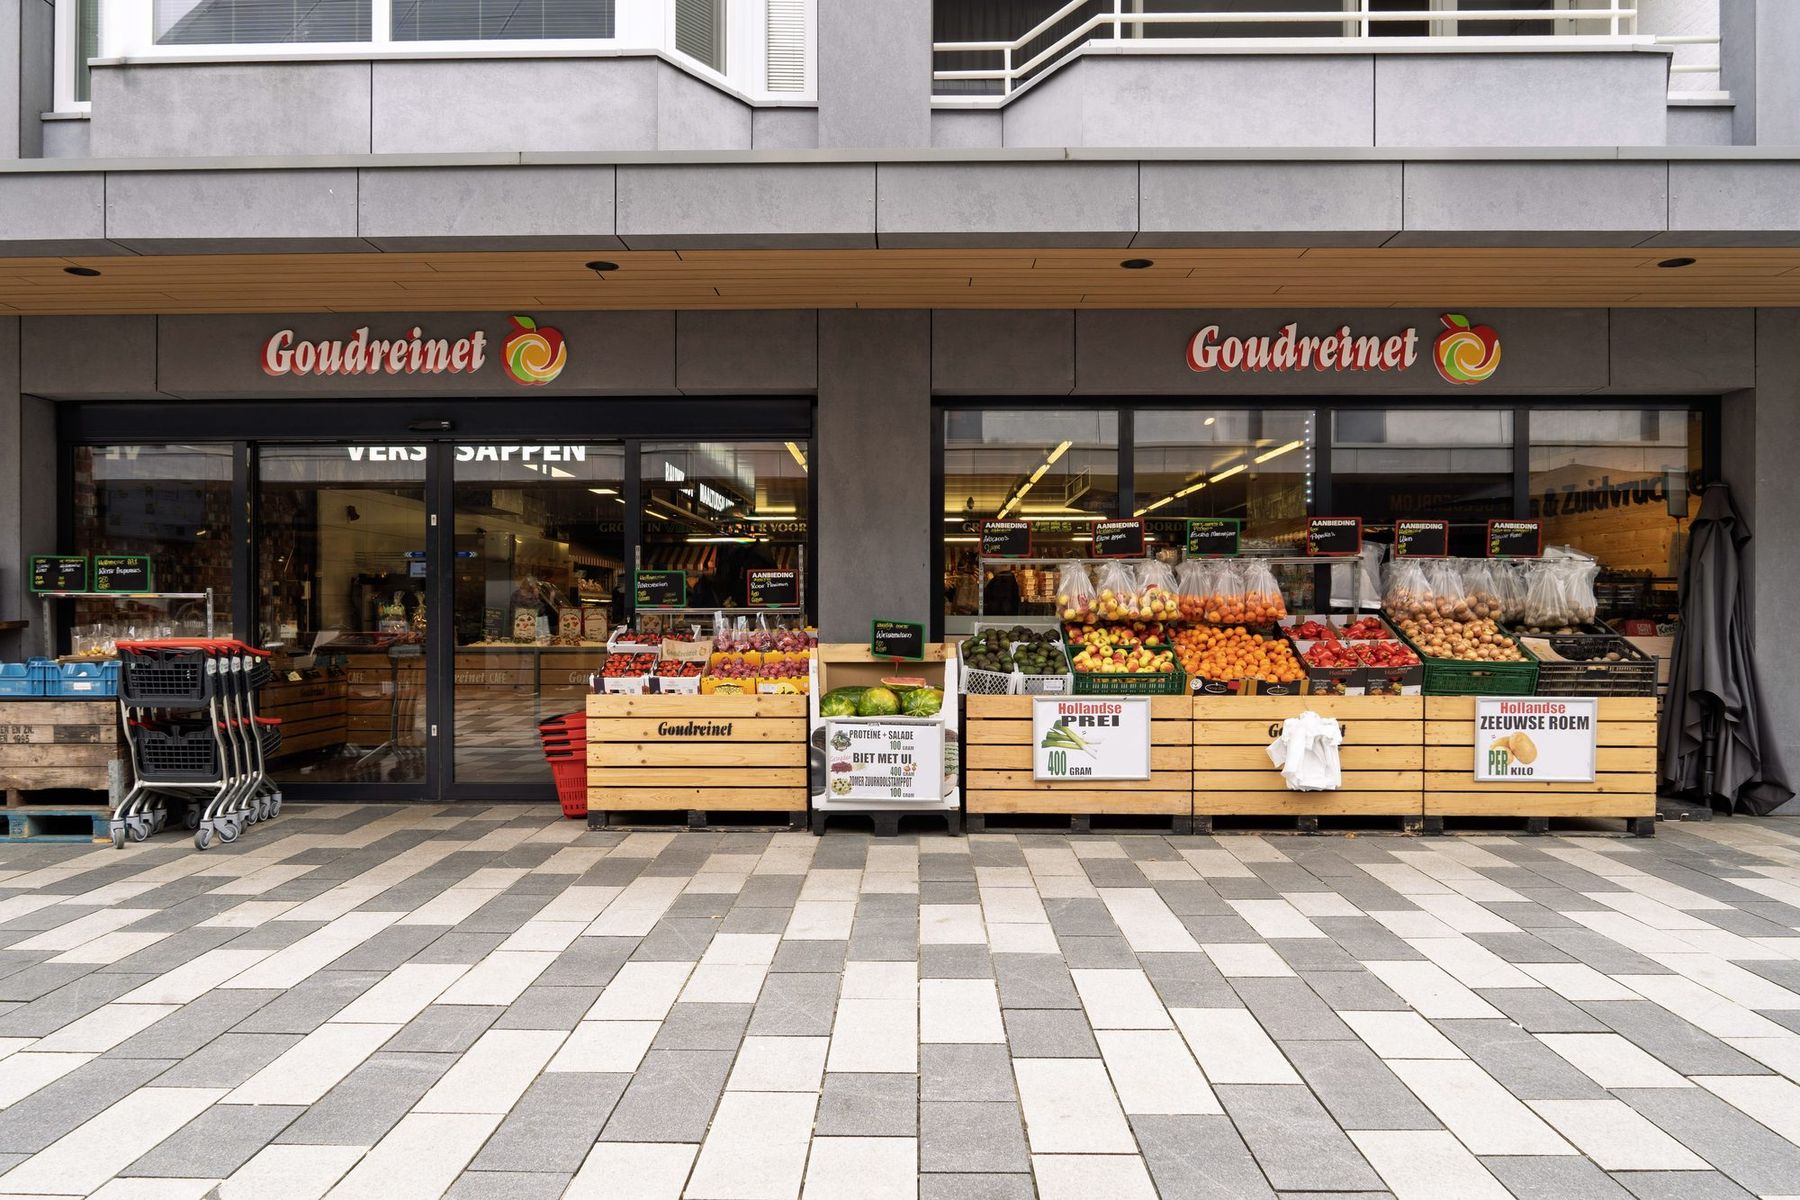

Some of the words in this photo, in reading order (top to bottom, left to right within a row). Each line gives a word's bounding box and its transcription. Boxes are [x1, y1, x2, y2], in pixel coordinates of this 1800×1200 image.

[261, 326, 487, 375] Goudreinet
[1186, 322, 1418, 372] Goudreinet
[985, 521, 1028, 529] AANBIEDING
[1096, 519, 1139, 528] AANBIEDING
[1400, 522, 1443, 530] AANBIEDING
[1494, 522, 1538, 530] AANBIEDING
[752, 571, 794, 579] AANBIEDING
[1058, 703, 1122, 714] Hollandse
[1500, 702, 1566, 714] Hollandse
[1061, 715, 1120, 727] PREI
[1480, 716, 1545, 730] ZEEUWSE
[1549, 716, 1590, 730] ROEM
[657, 721, 733, 736] Goudreinet
[888, 731, 914, 740] SALADE
[890, 741, 901, 750] 100
[853, 753, 875, 763] BIET
[878, 753, 898, 764] MET
[901, 754, 912, 764] UI
[1047, 750, 1067, 775] 400
[1488, 750, 1508, 775] PER
[890, 767, 901, 776] 400
[1069, 767, 1092, 775] GRAM
[1511, 767, 1534, 776] KILO
[890, 788, 901, 797] 100
